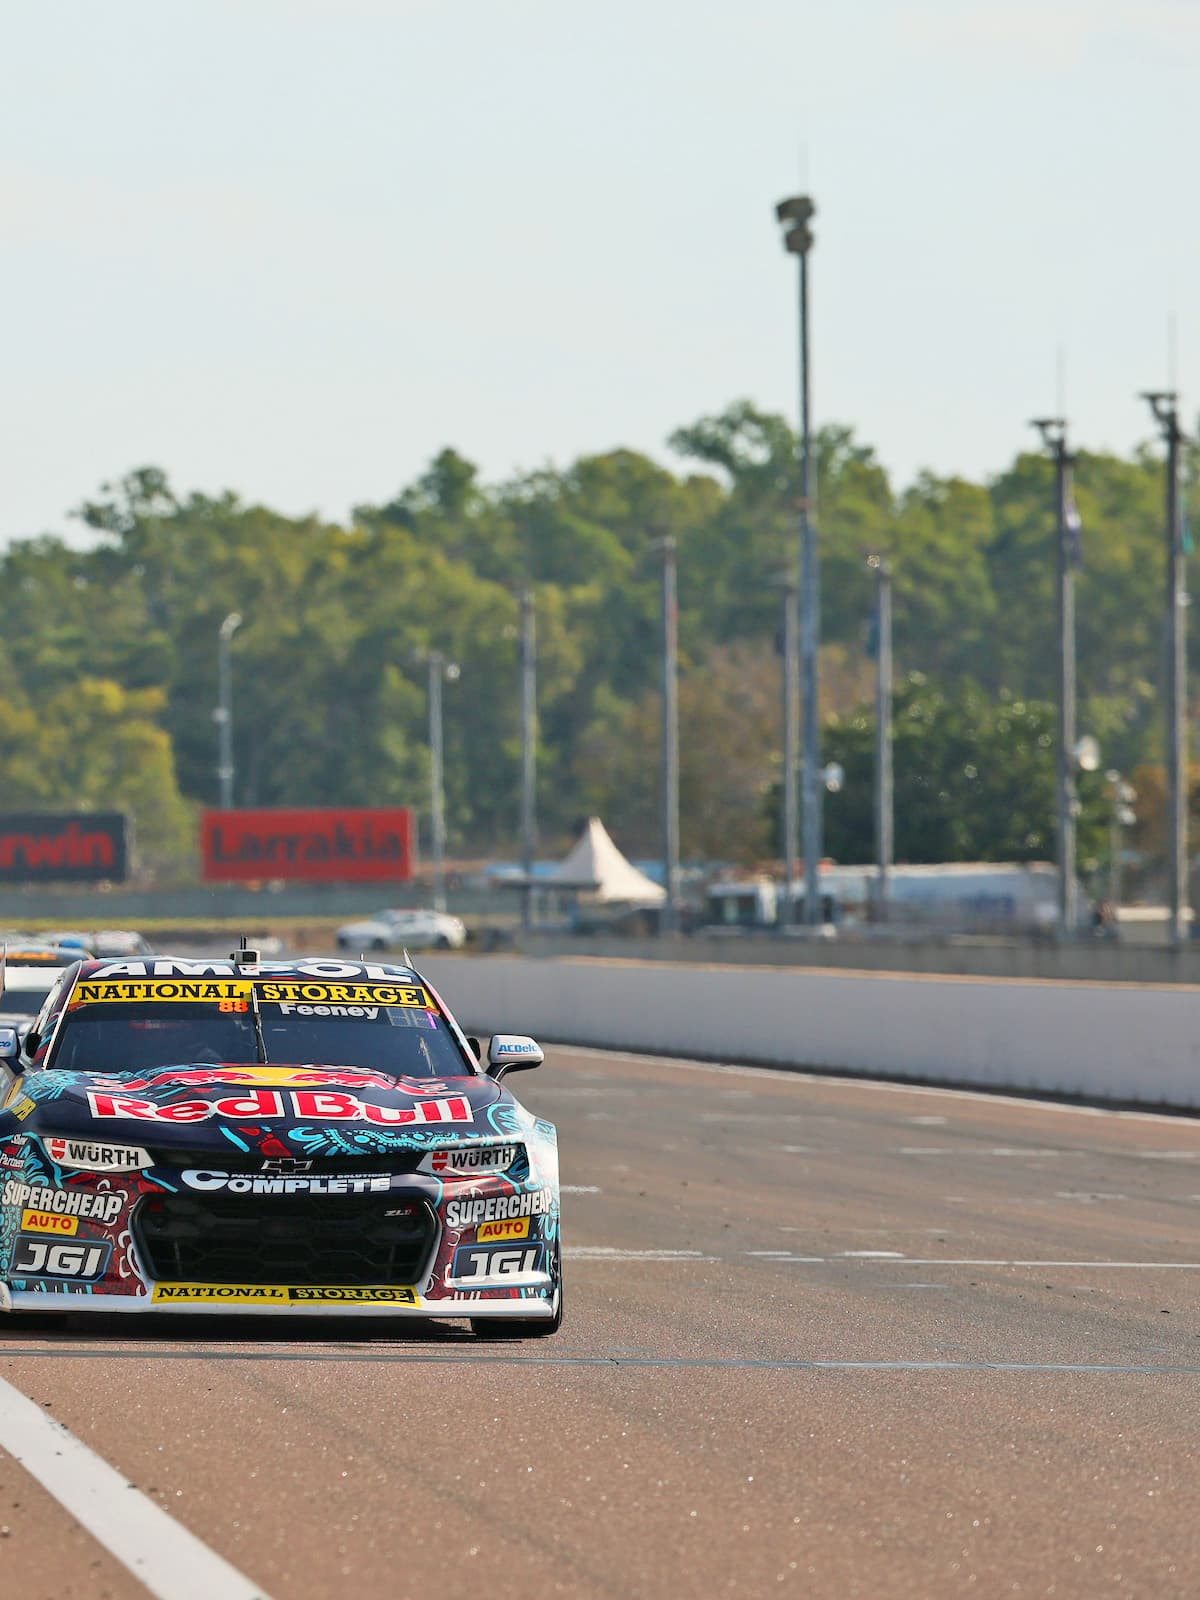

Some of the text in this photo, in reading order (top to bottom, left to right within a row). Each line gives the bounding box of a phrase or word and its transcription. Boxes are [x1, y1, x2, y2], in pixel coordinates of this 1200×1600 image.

[210, 820, 402, 864] Larrakia
[86, 958, 414, 983] AMPOL
[79, 983, 419, 1005] NATIONAL STORAGE
[217, 1001, 379, 1020] 88 Feeney
[86, 1089, 474, 1126] Red Bull
[2, 1180, 124, 1222] SUPERCHEAP
[446, 1188, 552, 1228] SUPERCHEAP
[27, 1214, 73, 1230] AUTO
[482, 1221, 524, 1237] AUTO
[16, 1243, 102, 1277] JGI
[461, 1250, 537, 1283] JGI
[157, 1287, 409, 1300] NATIONAL STORAGE
